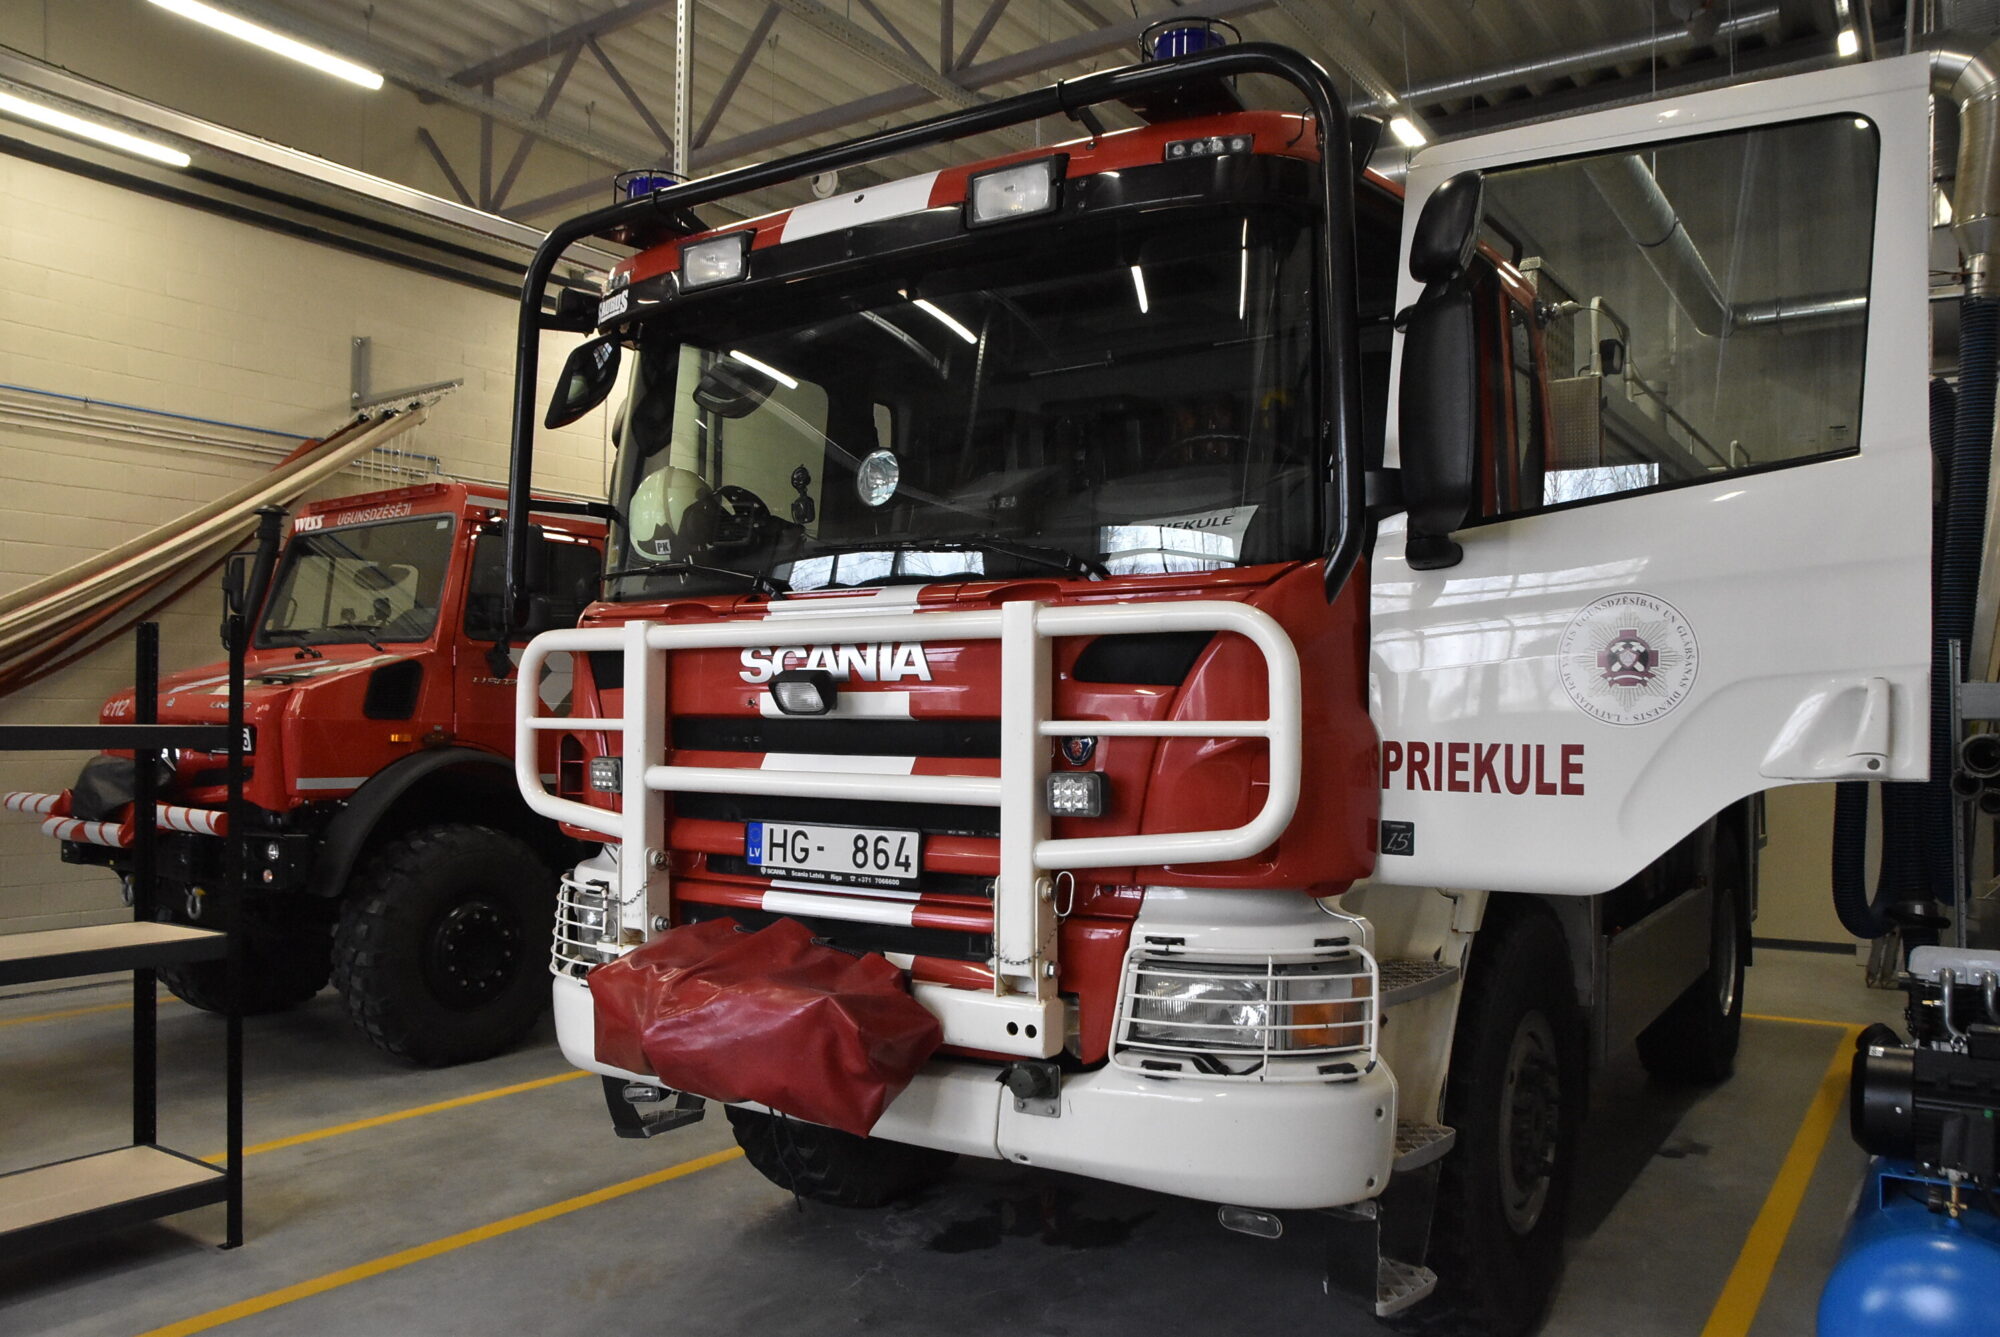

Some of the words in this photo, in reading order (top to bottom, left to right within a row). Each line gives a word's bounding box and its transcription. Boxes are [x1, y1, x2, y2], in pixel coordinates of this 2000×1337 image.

[656, 541, 670, 553] PK
[1663, 609, 1676, 623] UN
[739, 641, 932, 684] SCANIA
[1633, 691, 1682, 722] DIENESTS
[1382, 740, 1584, 795] PRIEKULE
[749, 847, 760, 858] LV
[852, 834, 911, 873] 864
